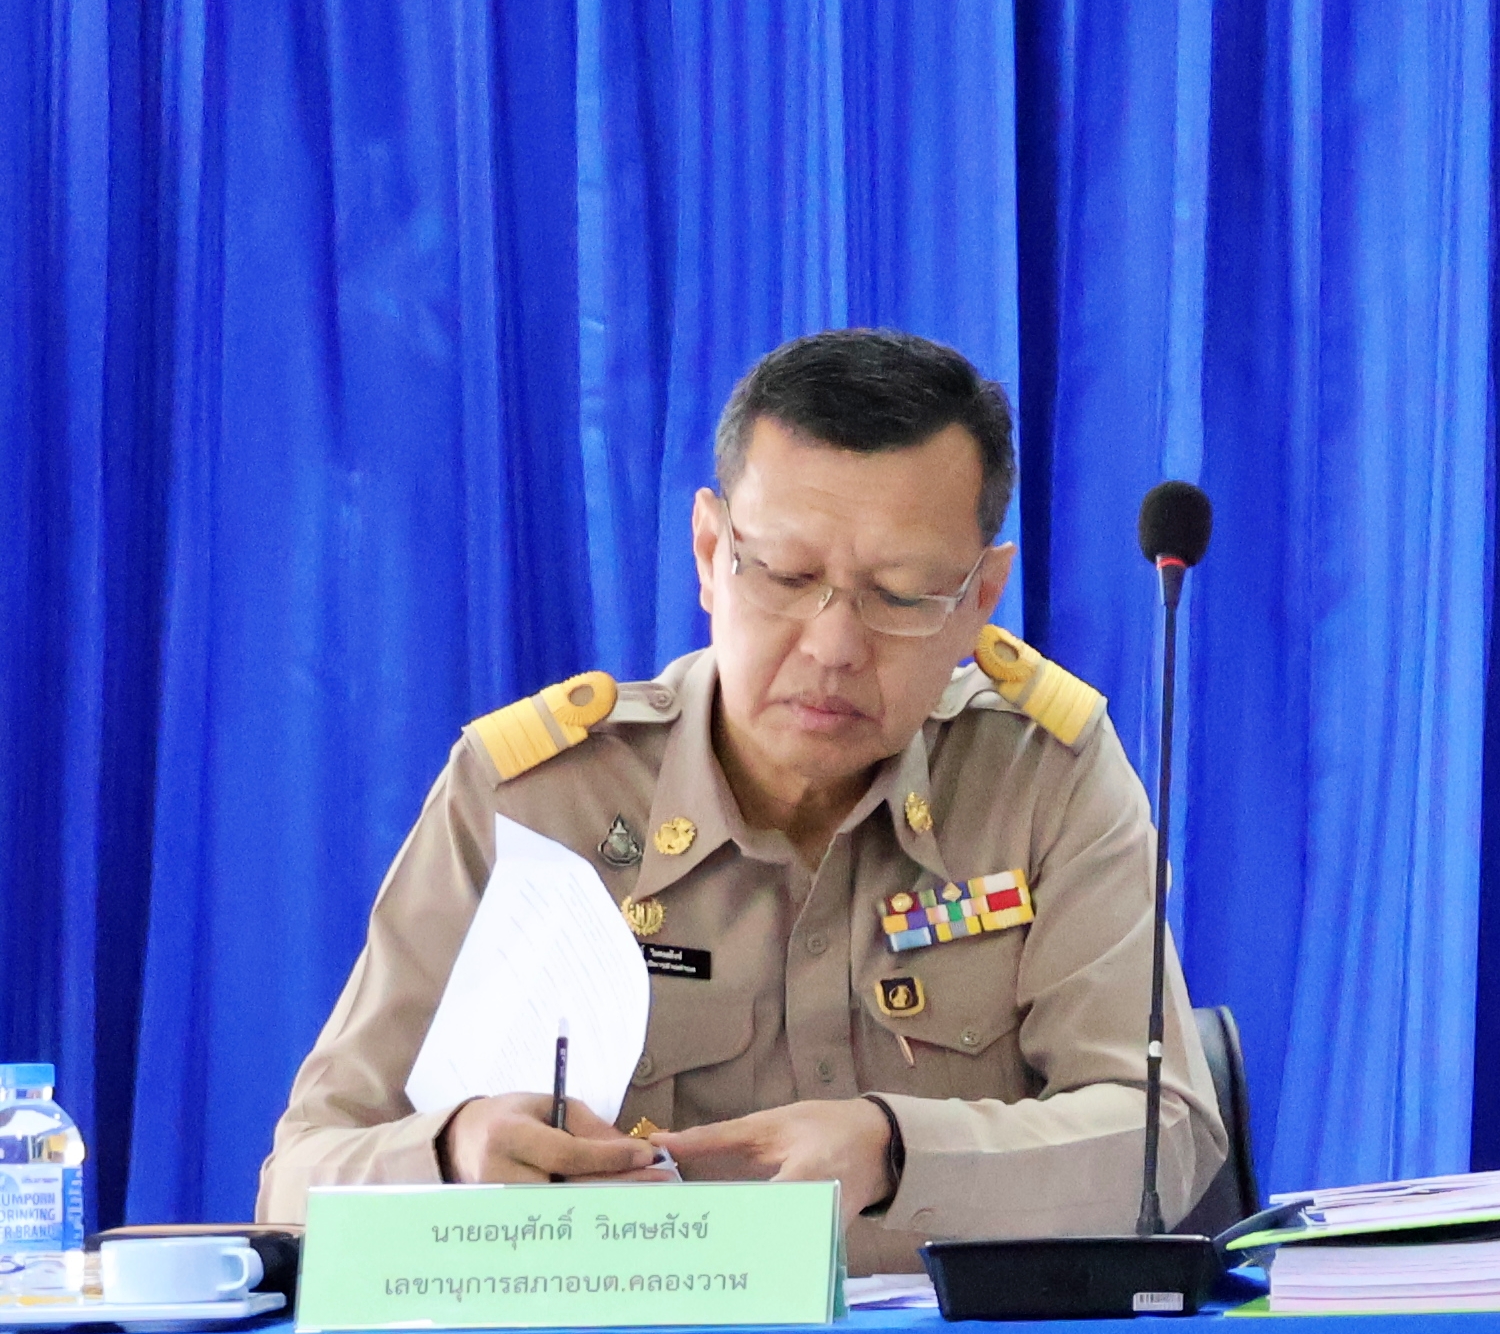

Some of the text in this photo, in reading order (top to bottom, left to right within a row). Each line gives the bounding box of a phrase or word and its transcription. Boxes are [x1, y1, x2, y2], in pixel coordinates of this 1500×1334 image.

[431, 1205, 711, 1252] นายอนุศักดิ์ วิเศษสังข์
[383, 1271, 750, 1305] เลขานุการสภาอบต.คลองวาฬ
